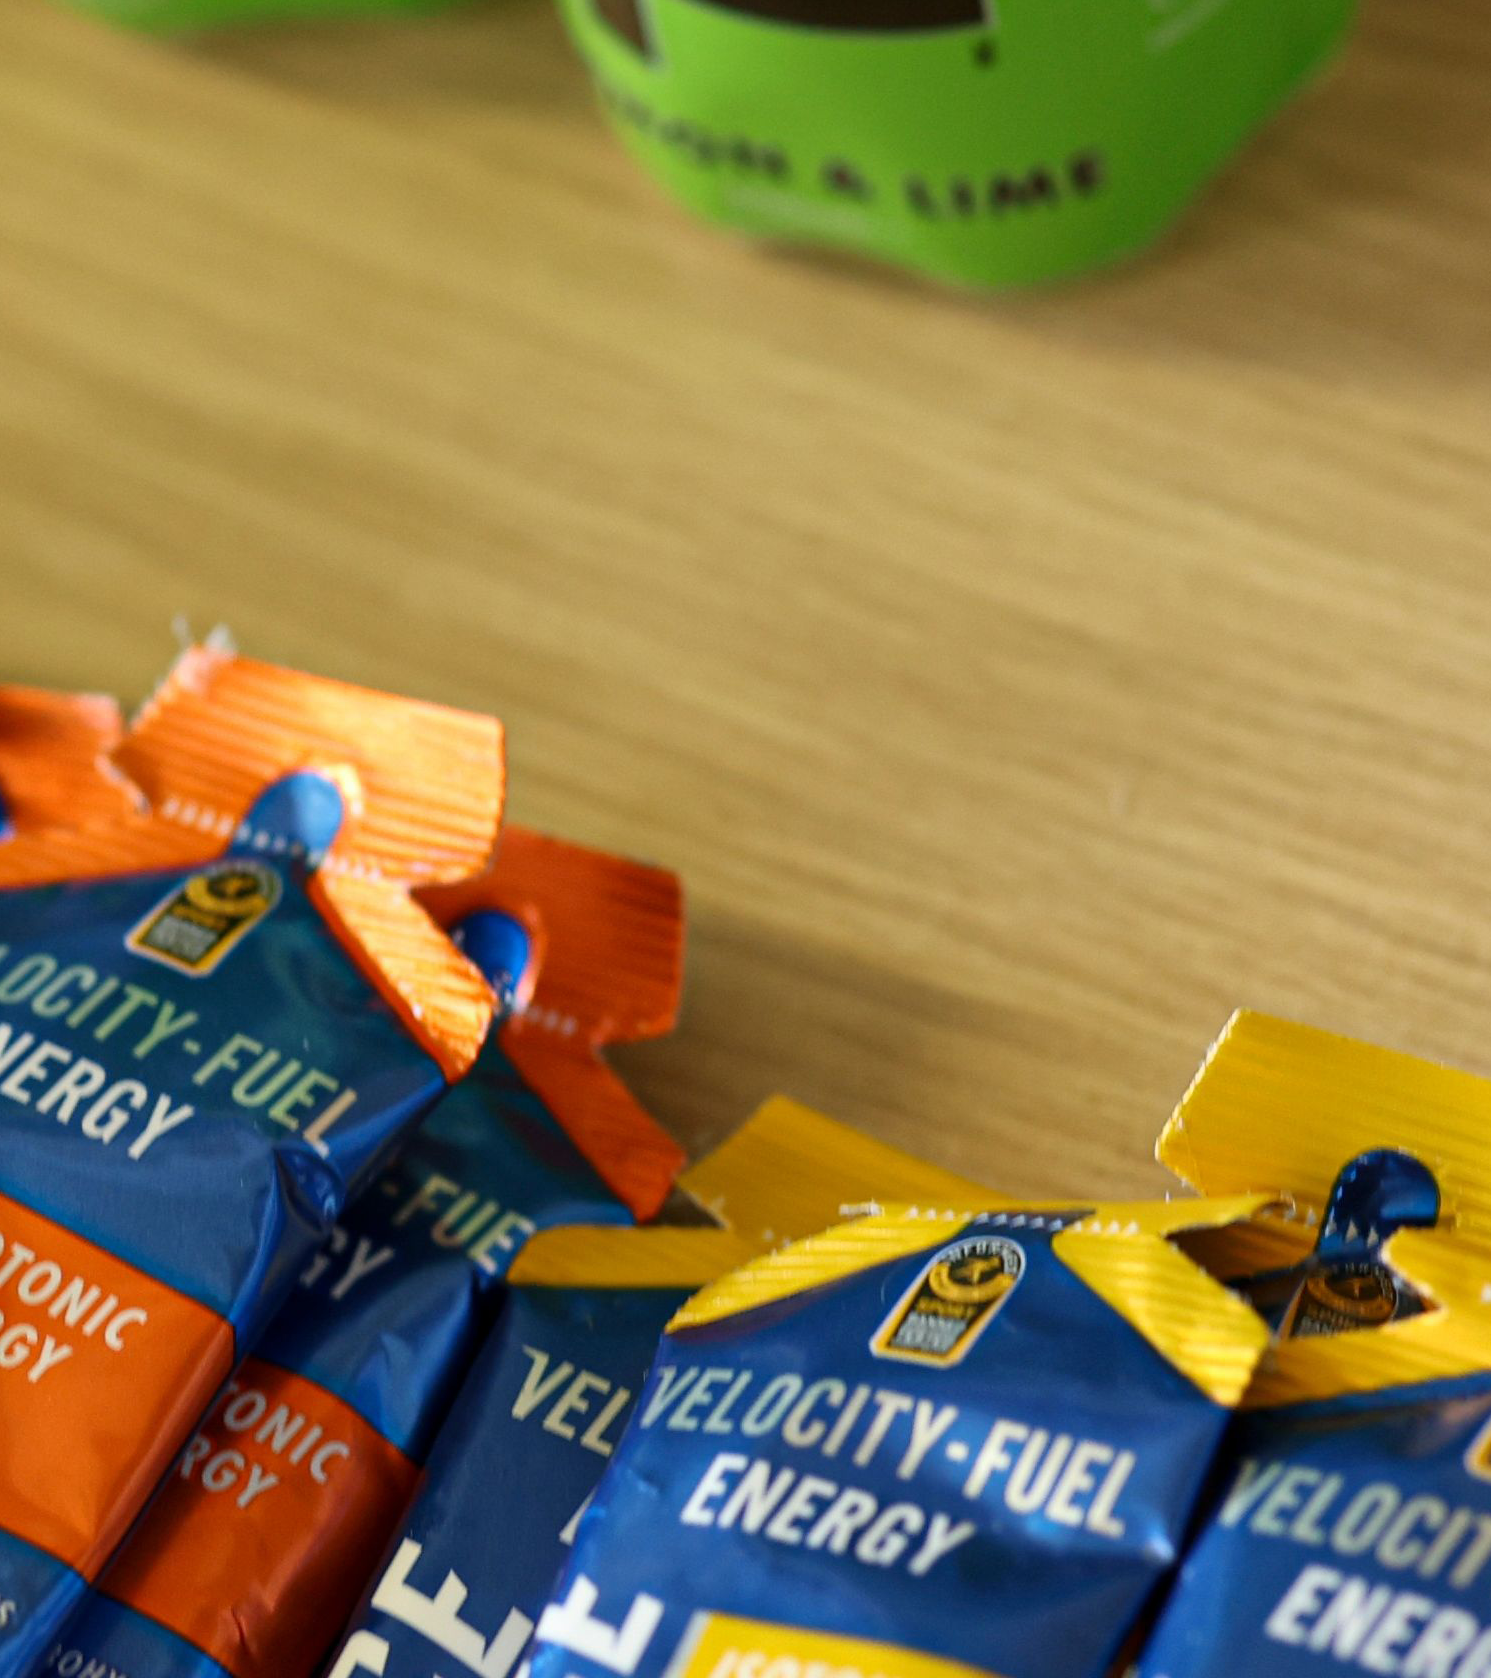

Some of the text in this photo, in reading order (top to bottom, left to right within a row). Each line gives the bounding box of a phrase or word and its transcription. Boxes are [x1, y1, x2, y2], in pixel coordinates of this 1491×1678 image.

[180, 1433, 280, 1509] RGY
[220, 1382, 351, 1486] ONIC
[639, 1364, 1137, 1541] VELOCITY-FUEL
[679, 1451, 976, 1579] ENERGY
